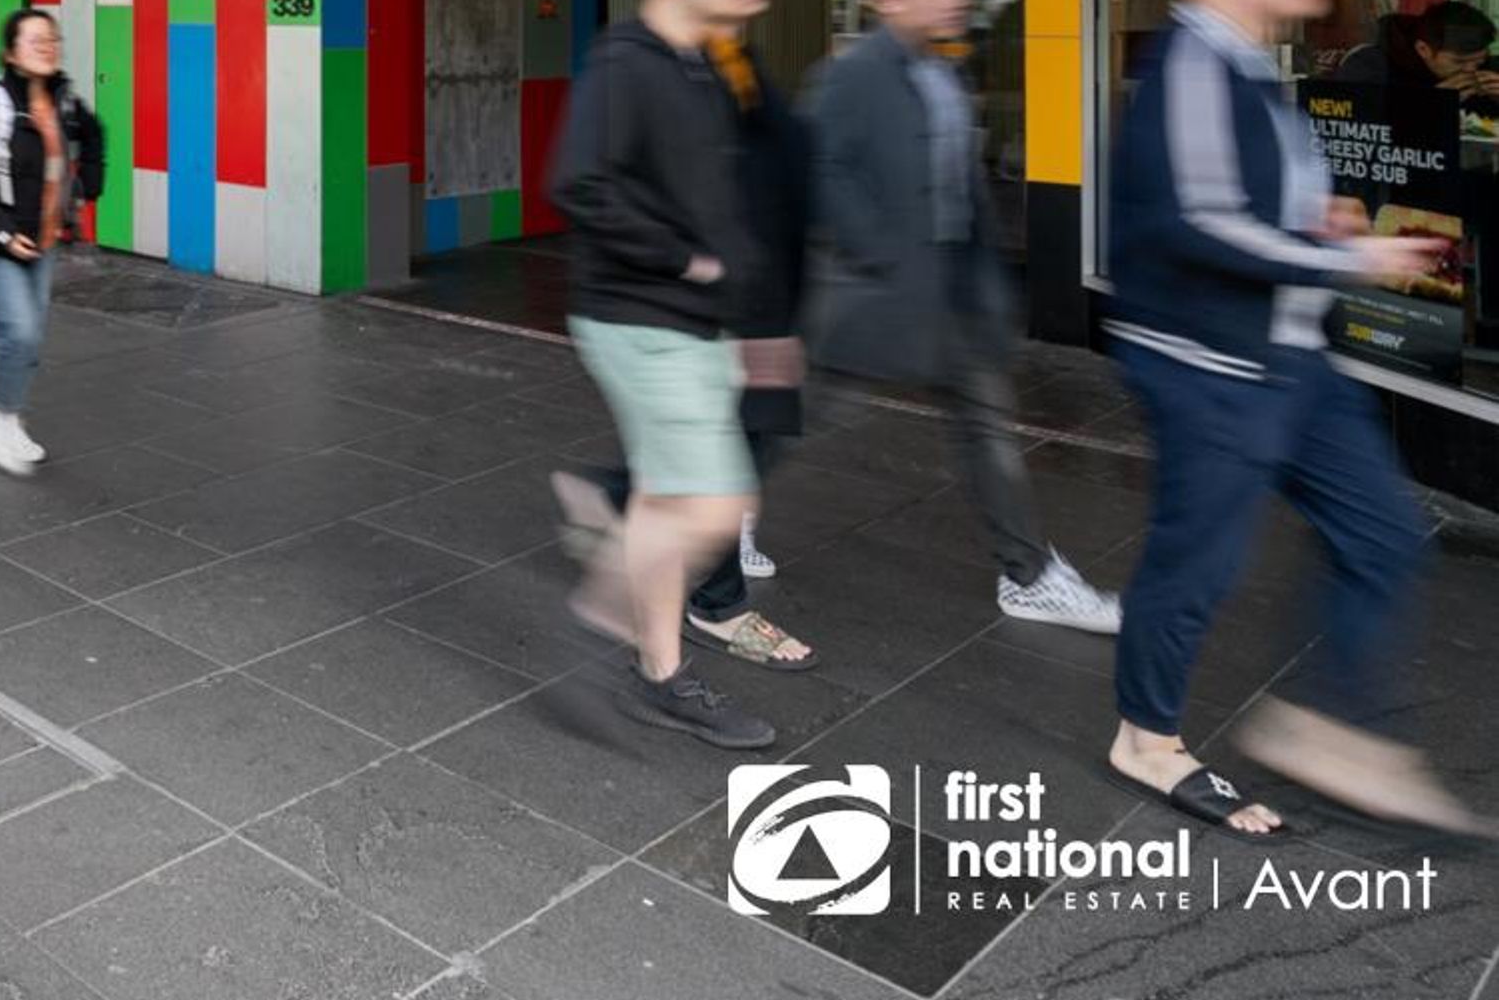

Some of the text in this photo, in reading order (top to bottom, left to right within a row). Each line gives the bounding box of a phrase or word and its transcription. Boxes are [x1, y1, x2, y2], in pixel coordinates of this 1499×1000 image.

[1309, 98, 1353, 118] NEW!
[1309, 118, 1393, 143] ULTIMATE
[1309, 136, 1445, 171] CHEESY GARLIC
[1370, 162, 1408, 185] SUB
